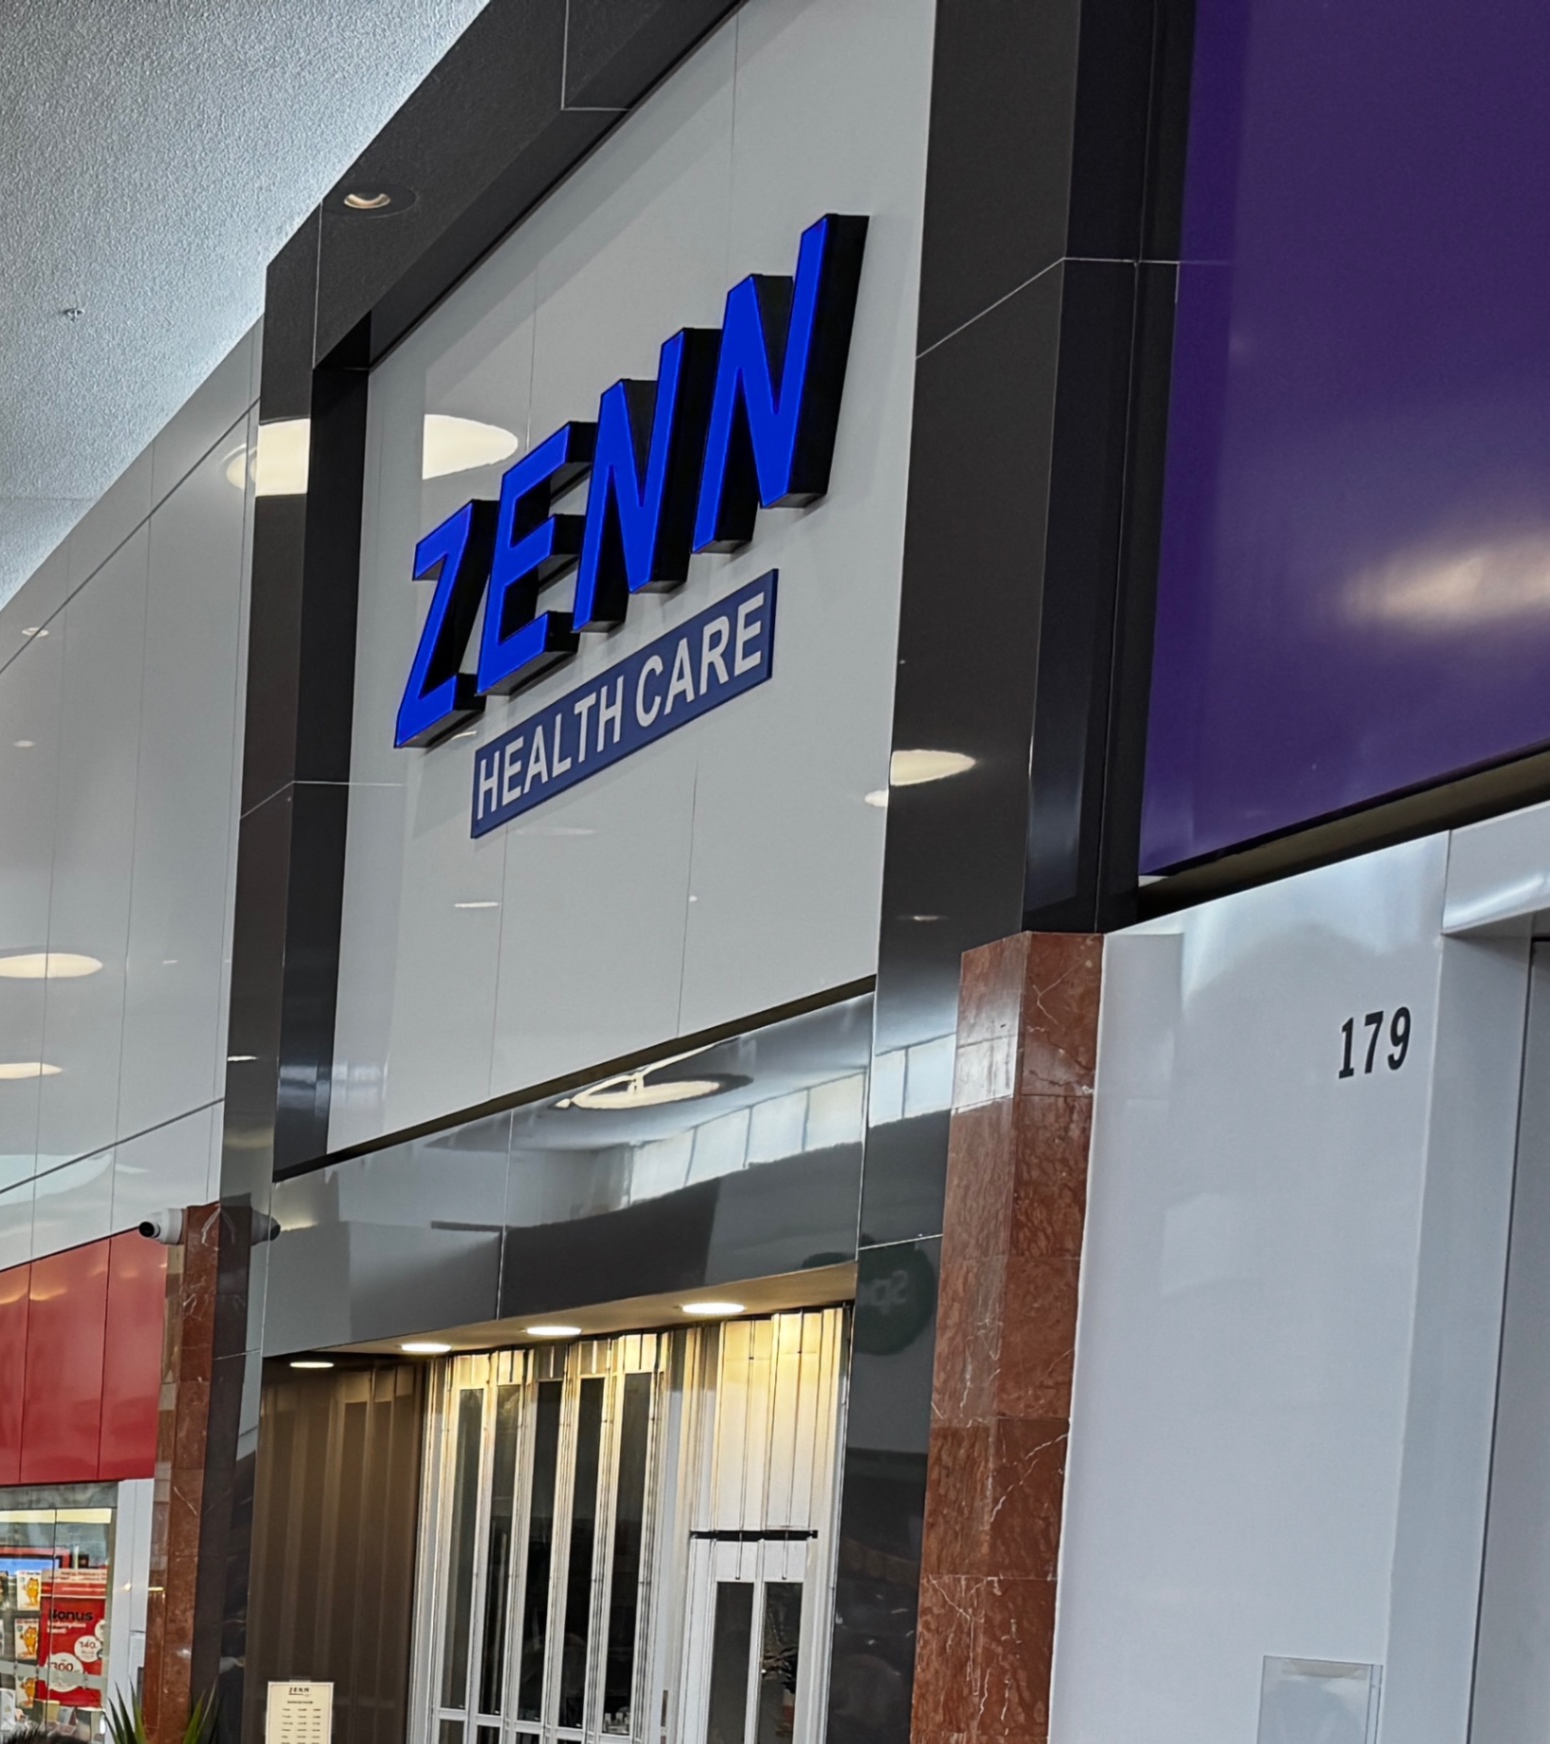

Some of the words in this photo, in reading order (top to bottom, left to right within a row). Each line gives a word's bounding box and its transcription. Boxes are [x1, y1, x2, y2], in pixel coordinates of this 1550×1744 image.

[395, 214, 859, 748] ZENN
[476, 680, 625, 820] HEALTH
[635, 591, 765, 729] CARE
[1338, 1007, 1412, 1078] 179
